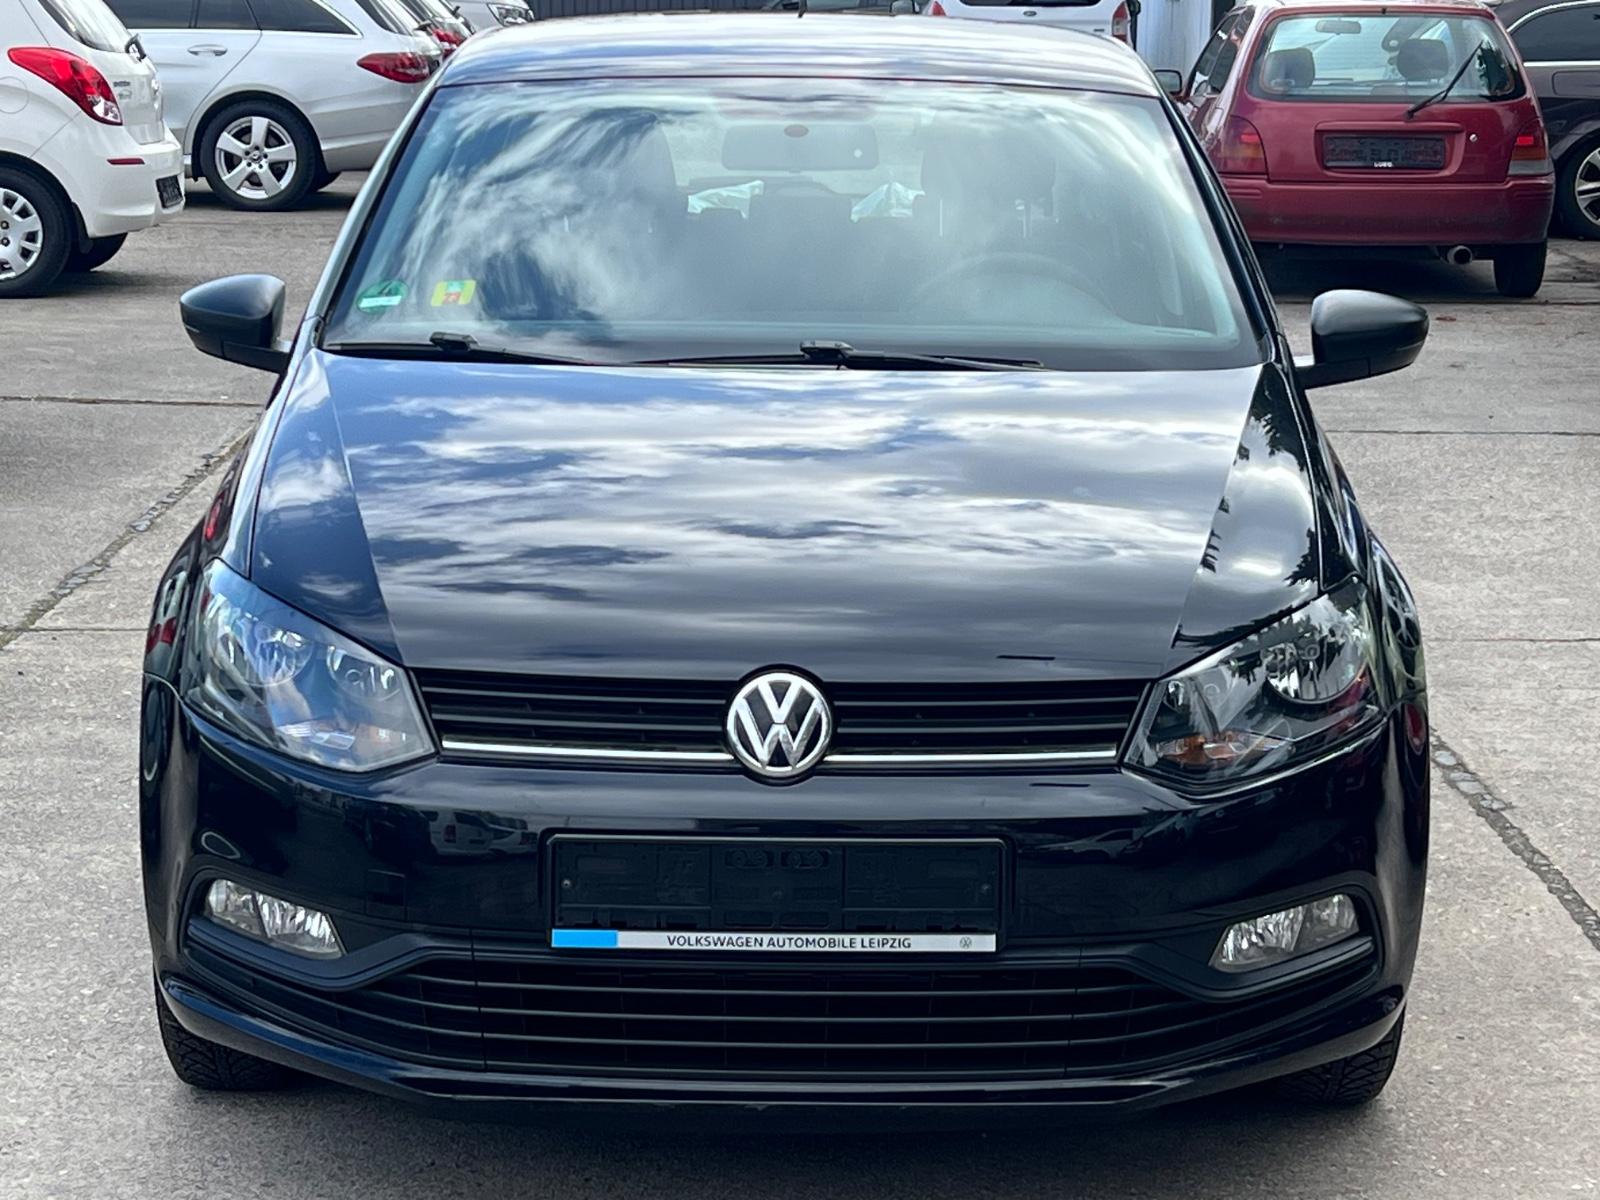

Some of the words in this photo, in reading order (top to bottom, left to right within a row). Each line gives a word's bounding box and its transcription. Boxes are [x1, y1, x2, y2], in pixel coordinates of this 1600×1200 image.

[667, 935, 764, 948] VOLKSWAGEN
[767, 936, 857, 949] AUTOMOBILE
[861, 937, 912, 949] LEIPZIG
